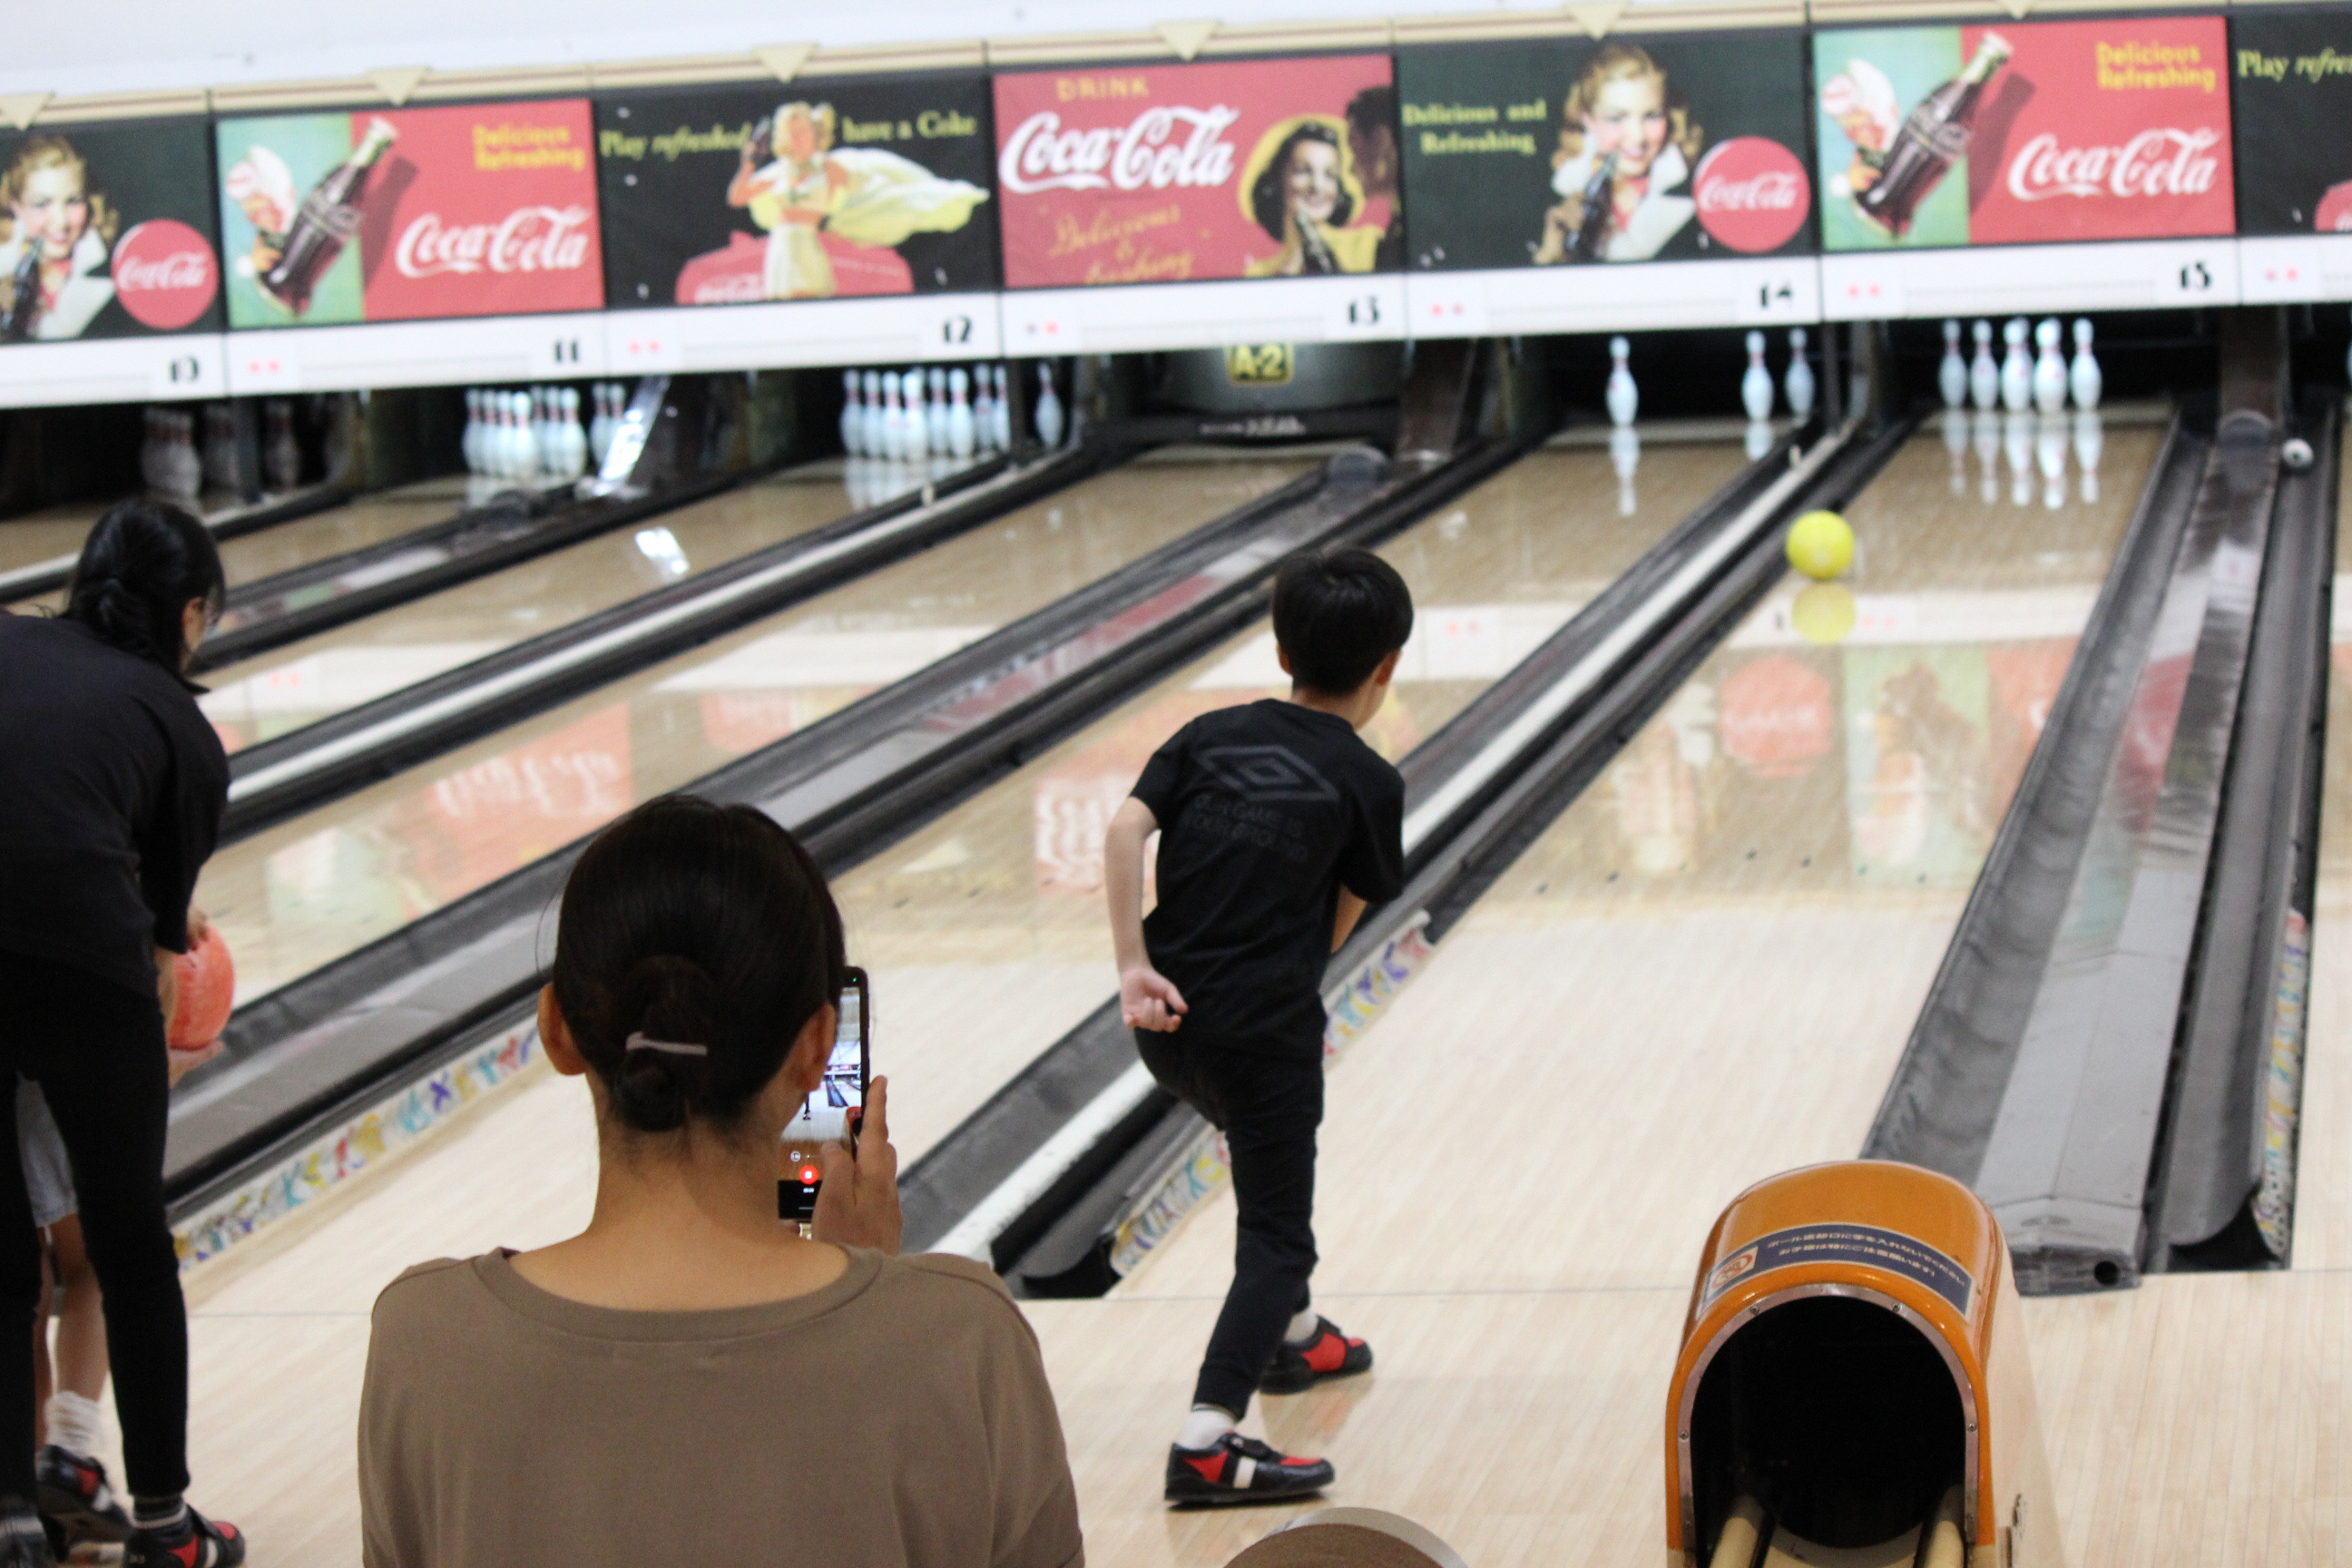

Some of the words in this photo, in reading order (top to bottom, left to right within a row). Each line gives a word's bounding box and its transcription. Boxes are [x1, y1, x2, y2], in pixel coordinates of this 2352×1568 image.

[2096, 41, 2200, 66] Delicious
[2237, 49, 2289, 82] Play
[1055, 77, 1149, 102] DRINK
[2097, 66, 2217, 93] Refreshing
[1402, 103, 1498, 127] Delicious
[1506, 100, 1547, 122] and
[599, 131, 647, 161] Play
[842, 116, 897, 143] have
[898, 122, 914, 140] a
[916, 111, 977, 139] Coke
[999, 103, 1240, 194] Coca-Cola
[1420, 130, 1536, 155] Refreshing
[2006, 127, 2220, 201] Coca-Cola
[395, 204, 589, 278] Coca-Cola
[2180, 261, 2211, 289] 15
[1759, 283, 1793, 309] 14
[1348, 296, 1380, 326] 13
[942, 315, 973, 343] 12
[554, 339, 580, 363] 11
[169, 355, 201, 382] 10
